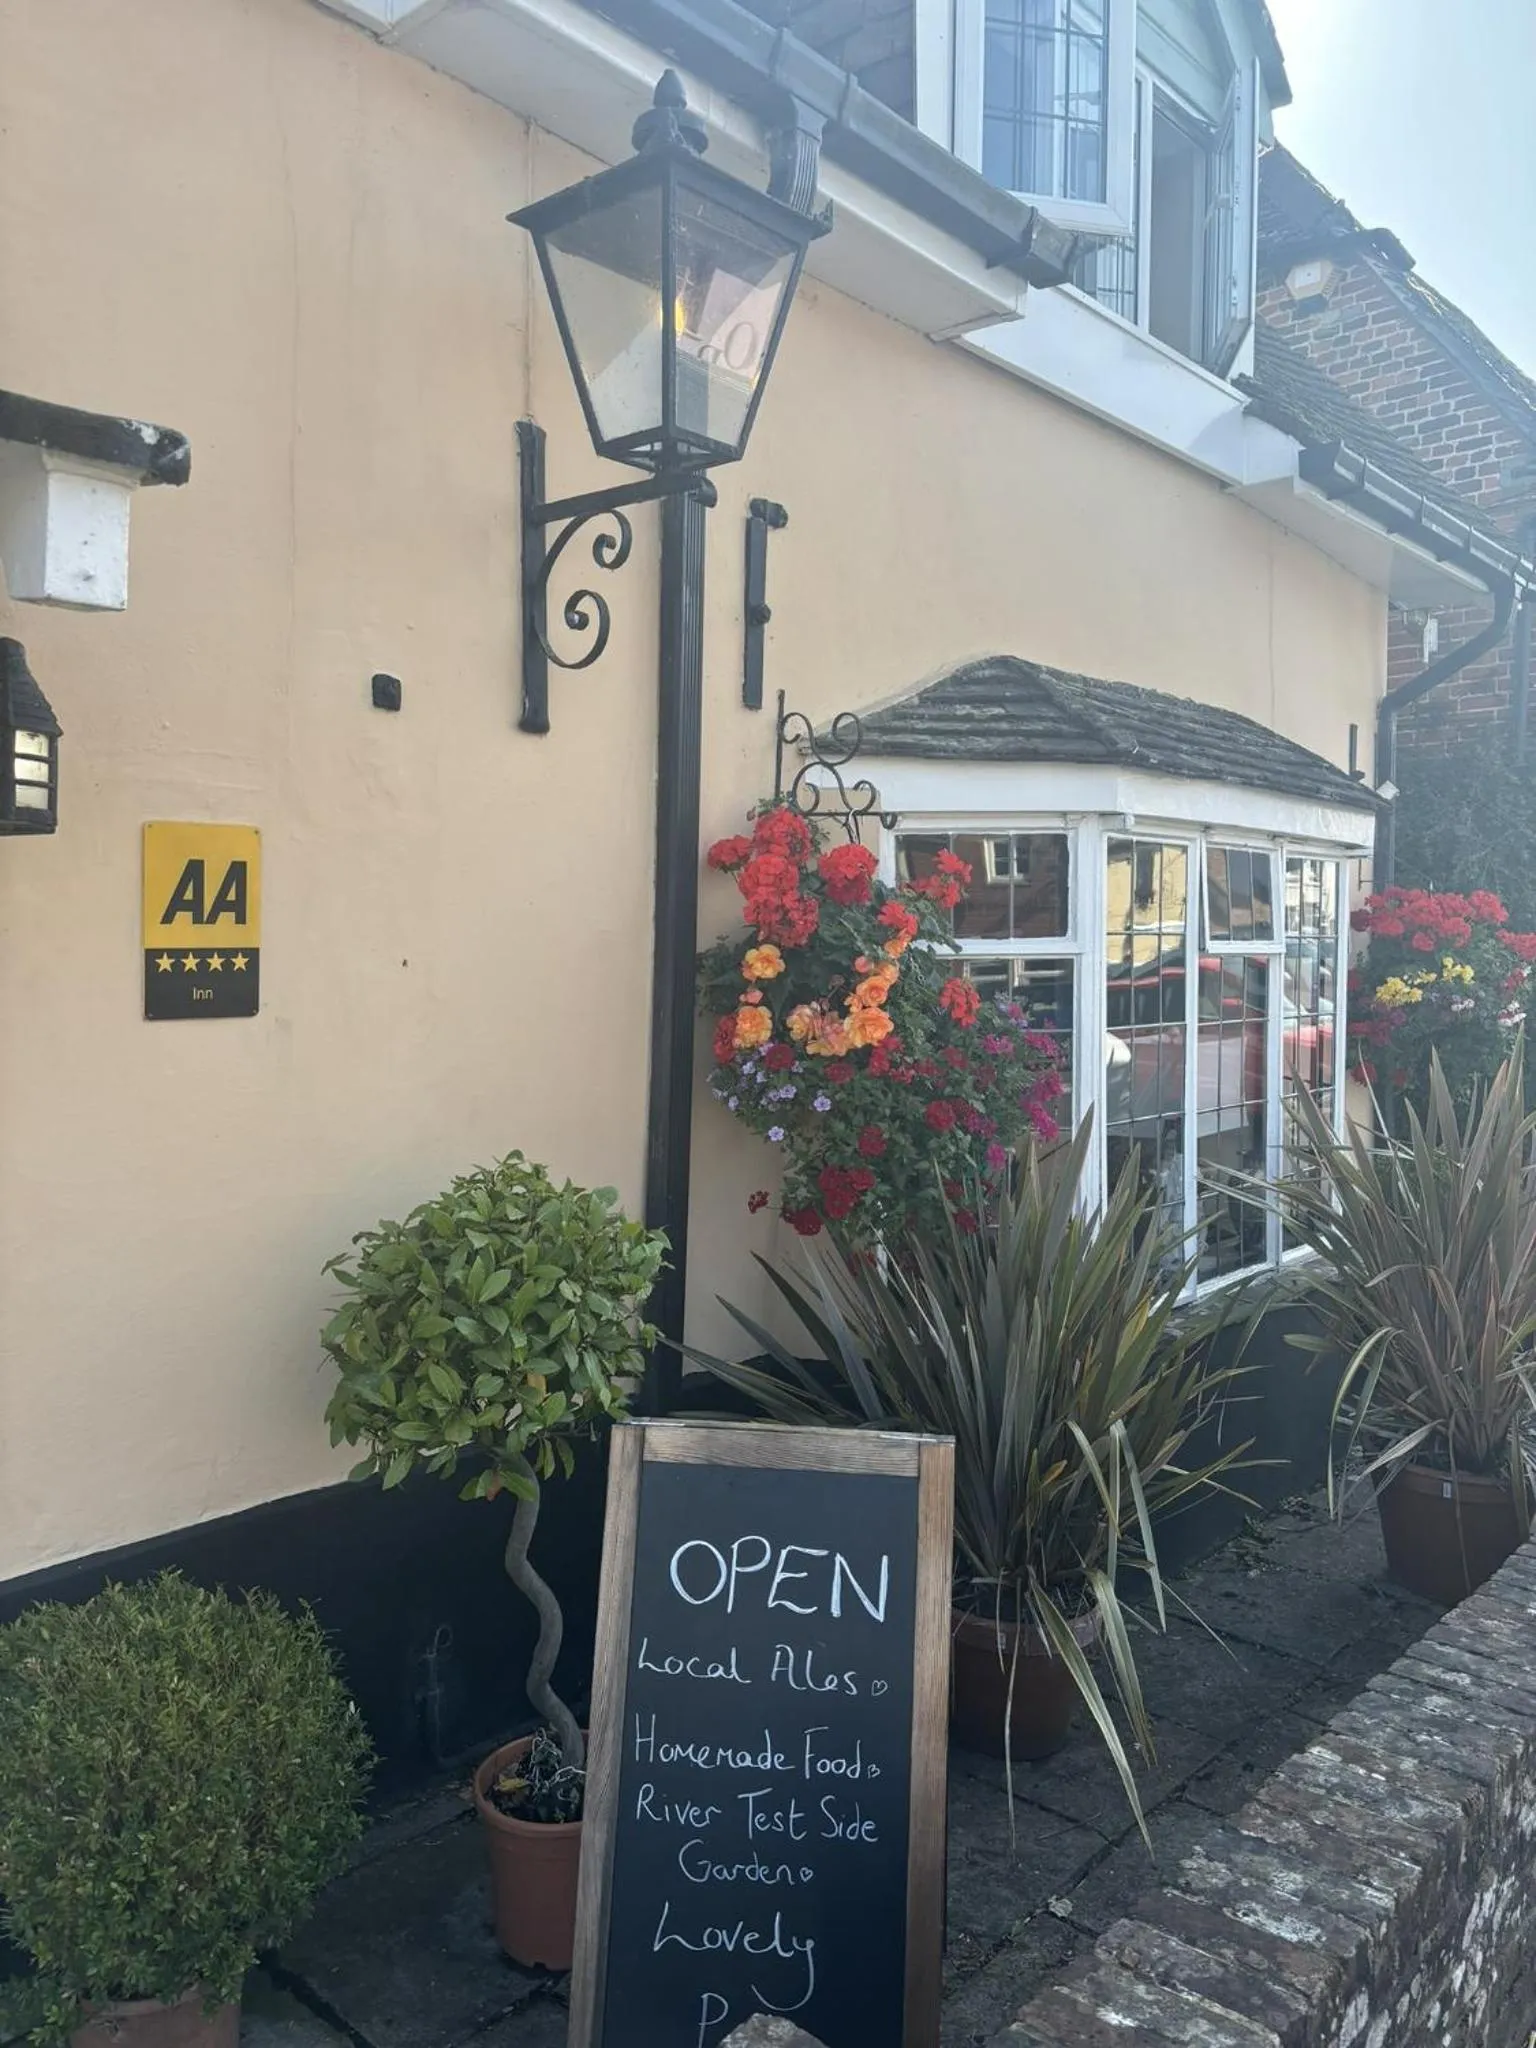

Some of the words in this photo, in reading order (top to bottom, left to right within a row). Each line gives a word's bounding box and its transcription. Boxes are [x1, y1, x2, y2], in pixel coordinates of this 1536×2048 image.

[160, 859, 248, 925] AA
[193, 987, 214, 1000] Inn
[669, 1535, 889, 1624] OPEN
[637, 1637, 753, 1684] Local
[770, 1644, 858, 1696] Ales
[635, 1712, 796, 1771] Homemade
[804, 1726, 861, 1780] Food
[636, 1783, 722, 1828] River
[737, 1787, 807, 1841] Test
[820, 1794, 878, 1843] Side
[678, 1835, 798, 1886] Garden
[653, 1900, 815, 2015] Lovely
